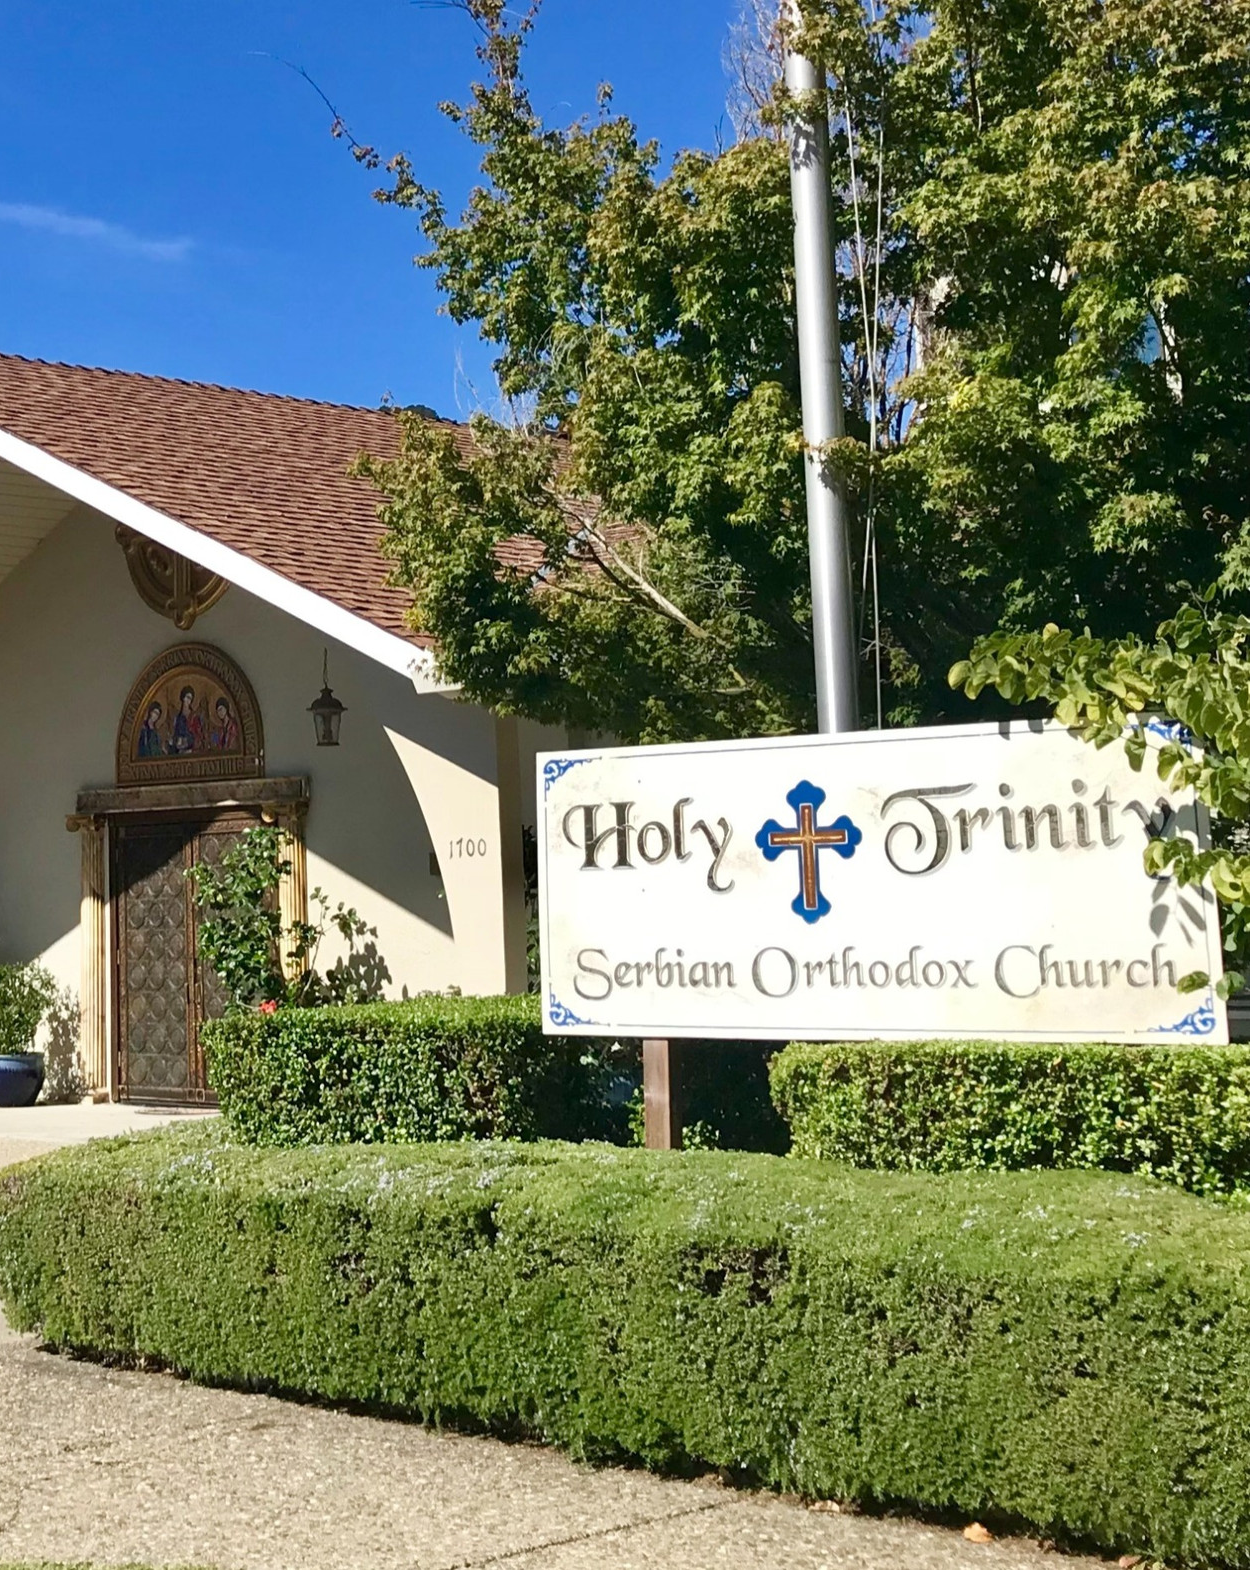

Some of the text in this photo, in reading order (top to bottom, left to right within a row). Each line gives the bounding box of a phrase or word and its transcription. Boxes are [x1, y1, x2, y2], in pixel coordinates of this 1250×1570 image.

[562, 781, 1172, 894] Holy Trinity
[573, 943, 1179, 1001] Serbian Orthodox Church
